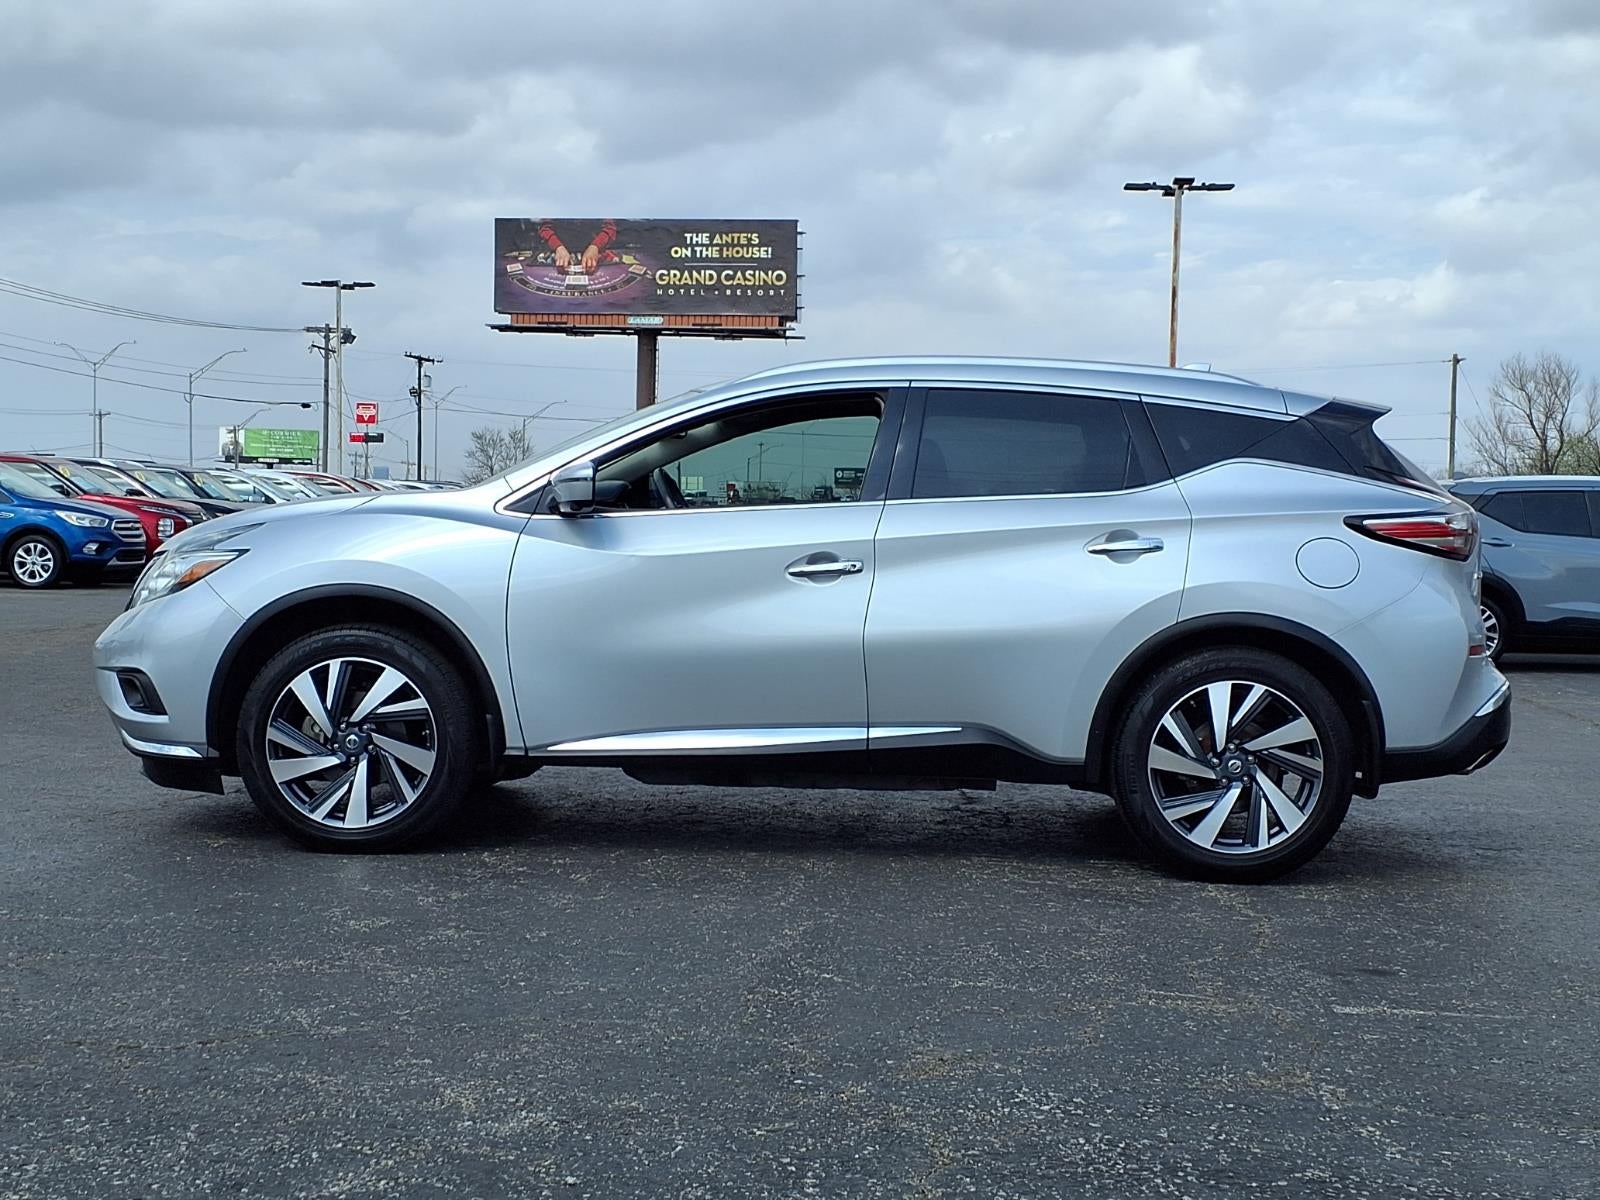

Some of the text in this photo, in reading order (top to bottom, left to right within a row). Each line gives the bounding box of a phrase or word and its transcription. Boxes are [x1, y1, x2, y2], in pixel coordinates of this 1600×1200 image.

[684, 233, 760, 244] THE ANTE'S
[670, 247, 772, 258] ON THE HOUSE!
[655, 269, 787, 286] GRAND CASINO
